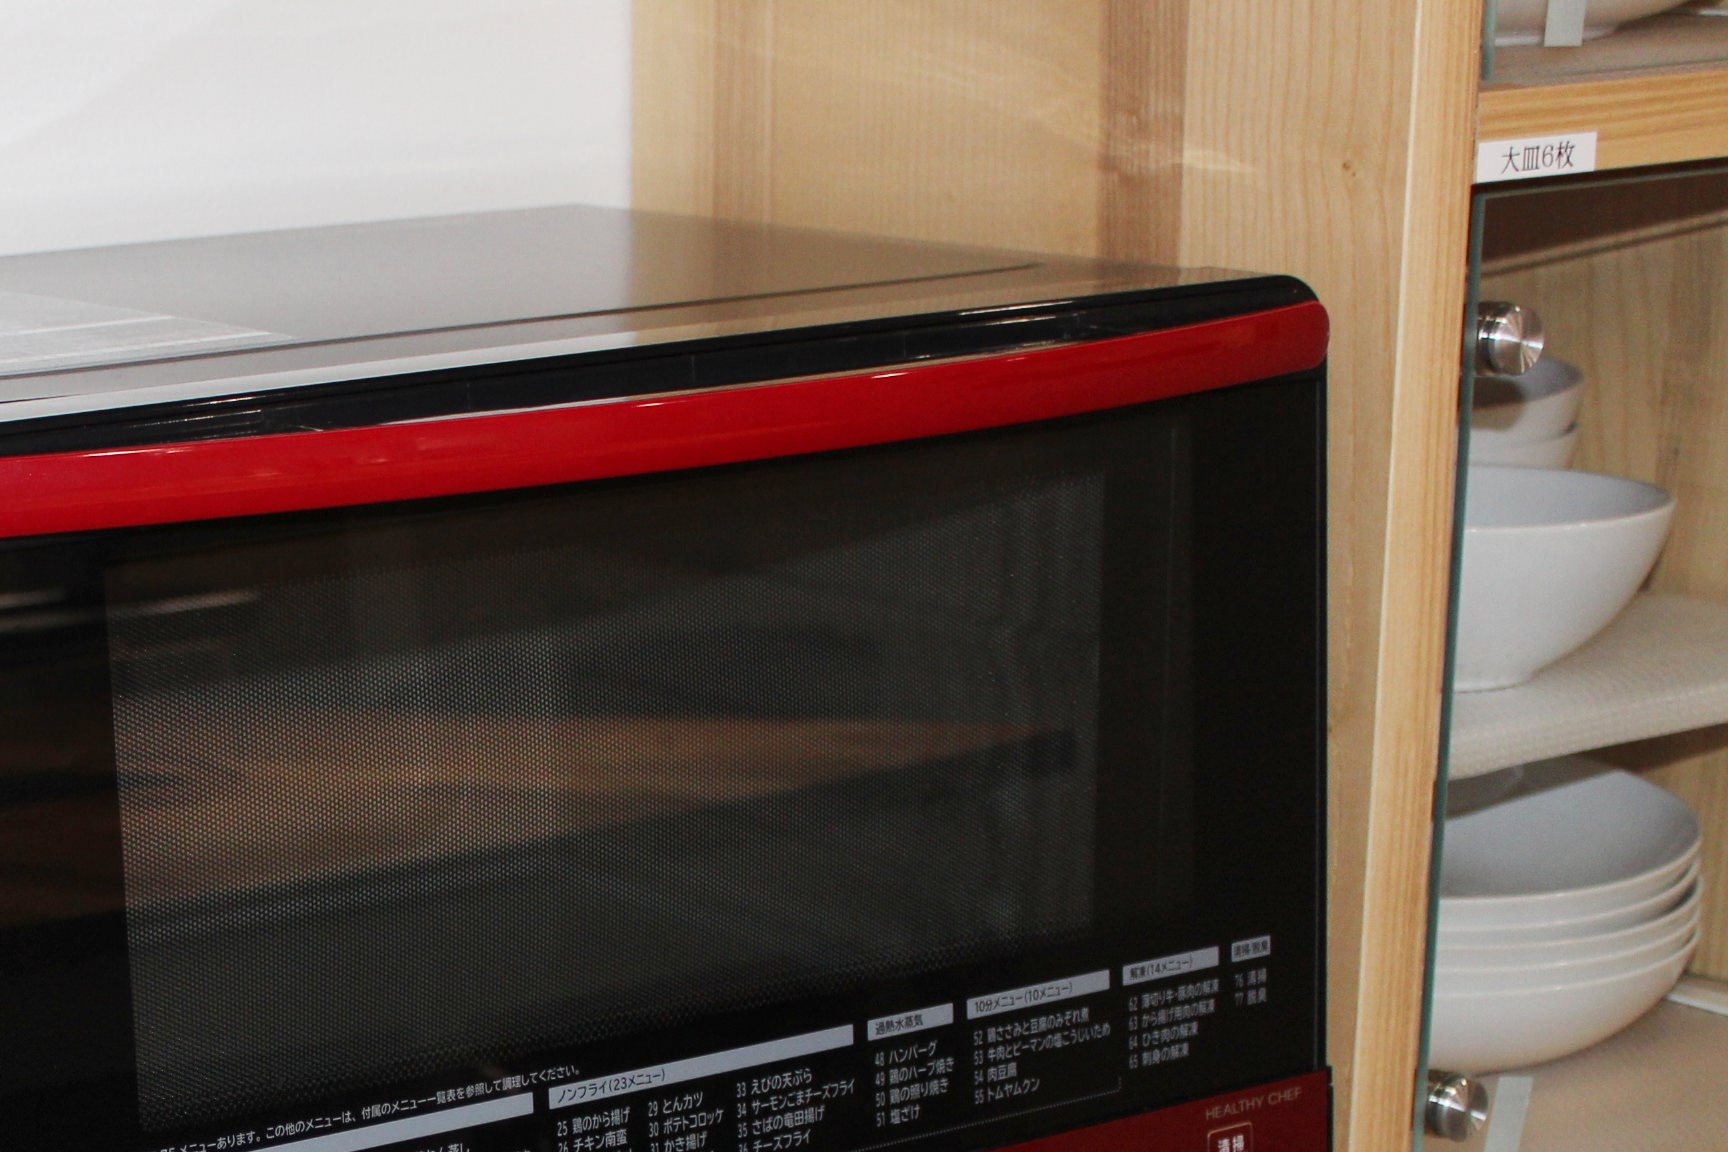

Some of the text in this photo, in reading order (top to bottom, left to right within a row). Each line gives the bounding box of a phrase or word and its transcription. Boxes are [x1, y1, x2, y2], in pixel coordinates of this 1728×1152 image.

[1501, 141, 1575, 174] 大皿6枚
[875, 1014, 923, 1036] 過熱水蒸気
[973, 1031, 984, 1046] 52
[875, 1040, 937, 1067] 48 ハンバーグ
[974, 1051, 984, 1065] 53
[736, 1068, 812, 1098] 33 えびの天ぷら
[875, 1072, 885, 1087] 49
[974, 1070, 984, 1085] 54
[648, 1091, 703, 1117] 29 とんカツ
[737, 1078, 856, 1118] 34 サーモンごまチーズフライ
[875, 1093, 886, 1107] 50
[974, 1090, 984, 1105] 55
[1206, 1086, 1302, 1120] HEALTHY CHEF
[557, 1106, 631, 1137] 25 鶏のから揚げ
[649, 1108, 724, 1137] 30 ポテトコロッケ
[737, 1105, 825, 1138] 35 さばの竜田揚げ
[876, 1113, 885, 1127] 51
